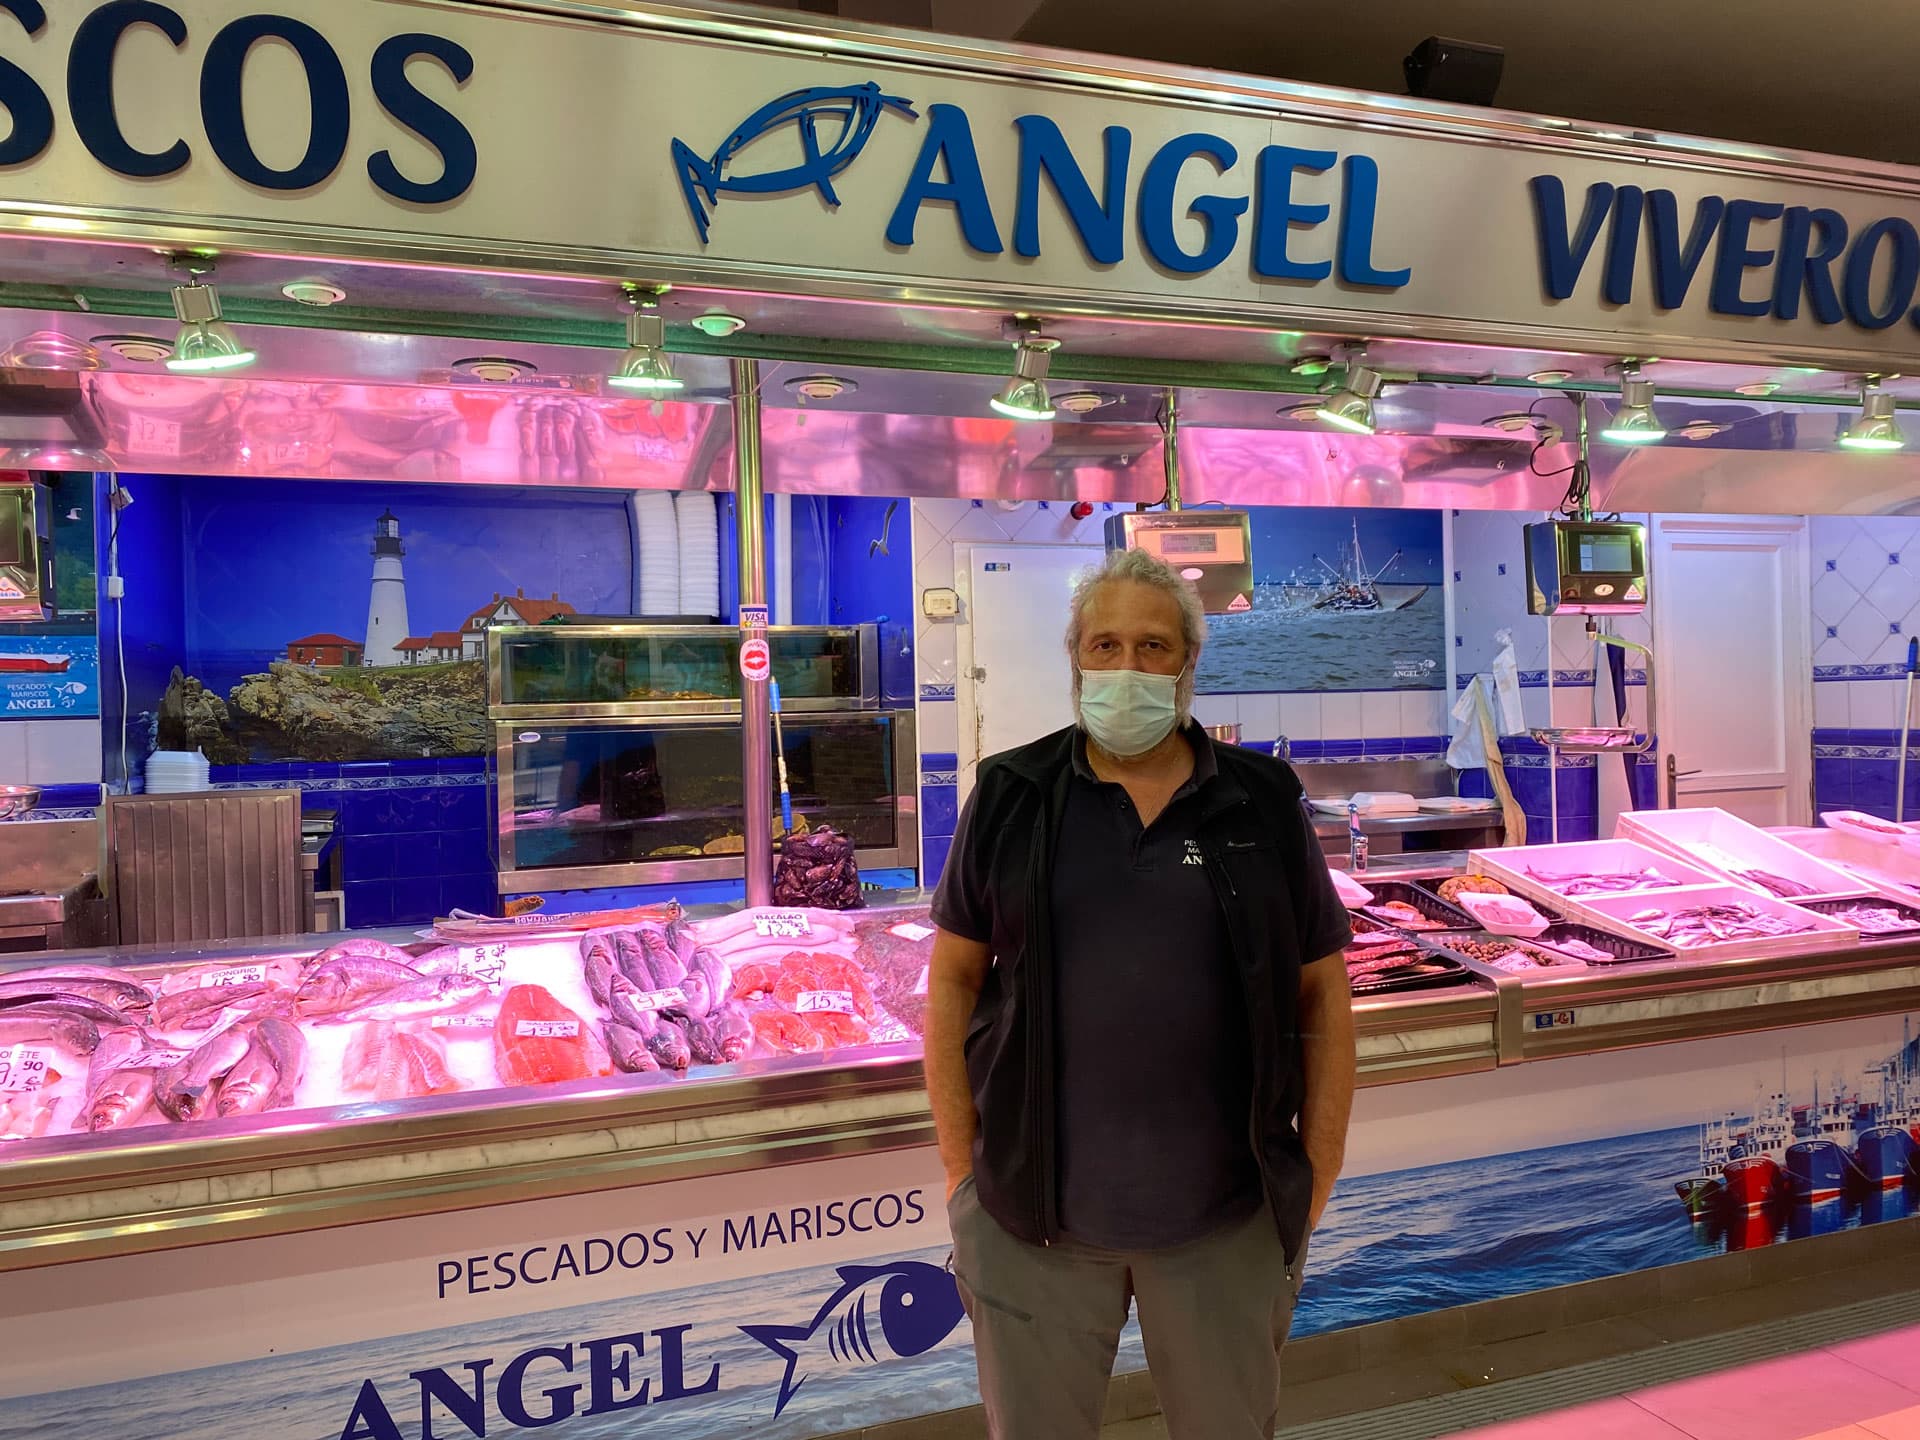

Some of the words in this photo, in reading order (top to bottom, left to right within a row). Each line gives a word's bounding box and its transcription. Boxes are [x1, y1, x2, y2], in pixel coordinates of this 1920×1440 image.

[885, 103, 1411, 288] ANGEL
[1530, 173, 1920, 330] VIVERO
[745, 613, 766, 621] VISA
[6, 699, 56, 710] ANGEL
[7, 683, 46, 691] PESCADOS
[436, 1227, 675, 1299] PESCADOS
[685, 1227, 710, 1259] Y
[722, 1189, 925, 1254] MARISCOS
[340, 1323, 721, 1440] ANGEL
